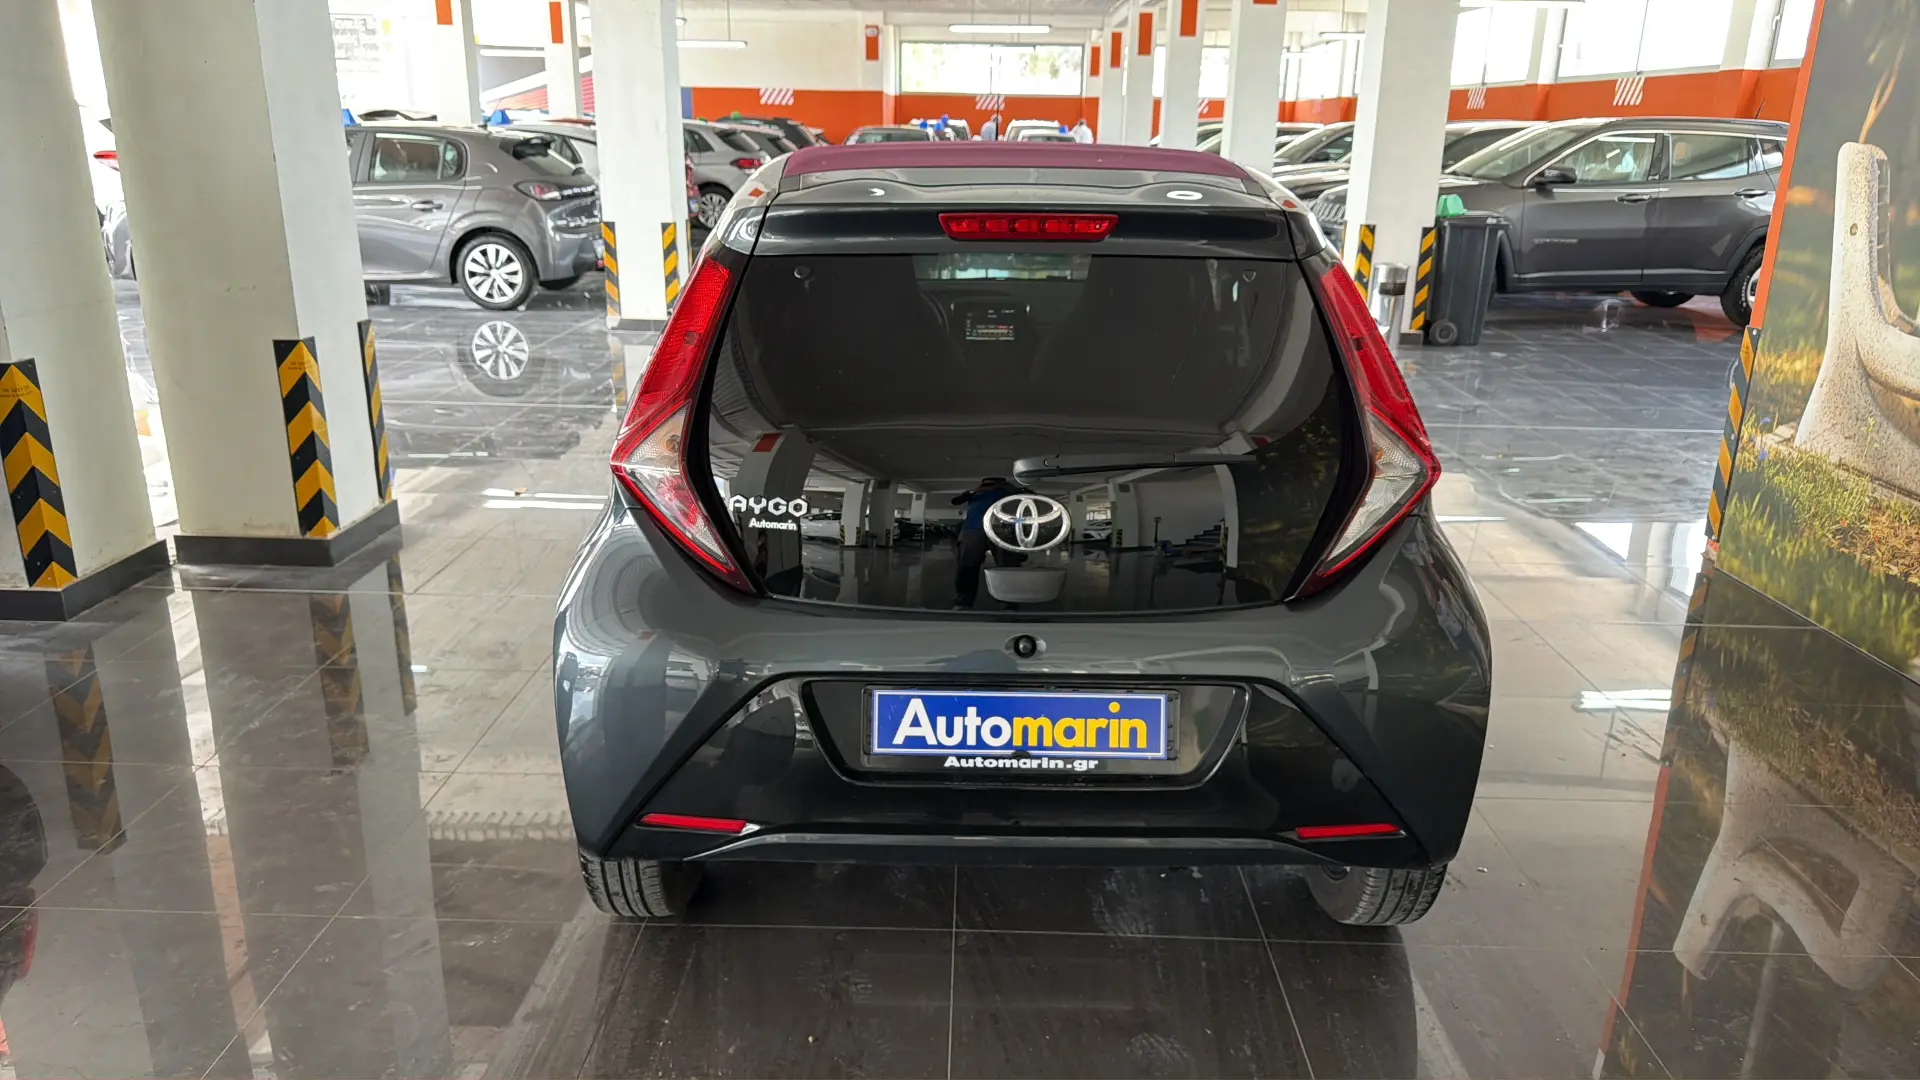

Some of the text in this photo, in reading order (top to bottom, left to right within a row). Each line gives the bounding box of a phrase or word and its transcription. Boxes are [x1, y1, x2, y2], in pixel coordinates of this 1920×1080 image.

[729, 494, 808, 518] AYGO
[748, 517, 797, 531] Automarin
[892, 698, 1148, 749] Automarin
[943, 756, 1099, 772] Automarin.gr
